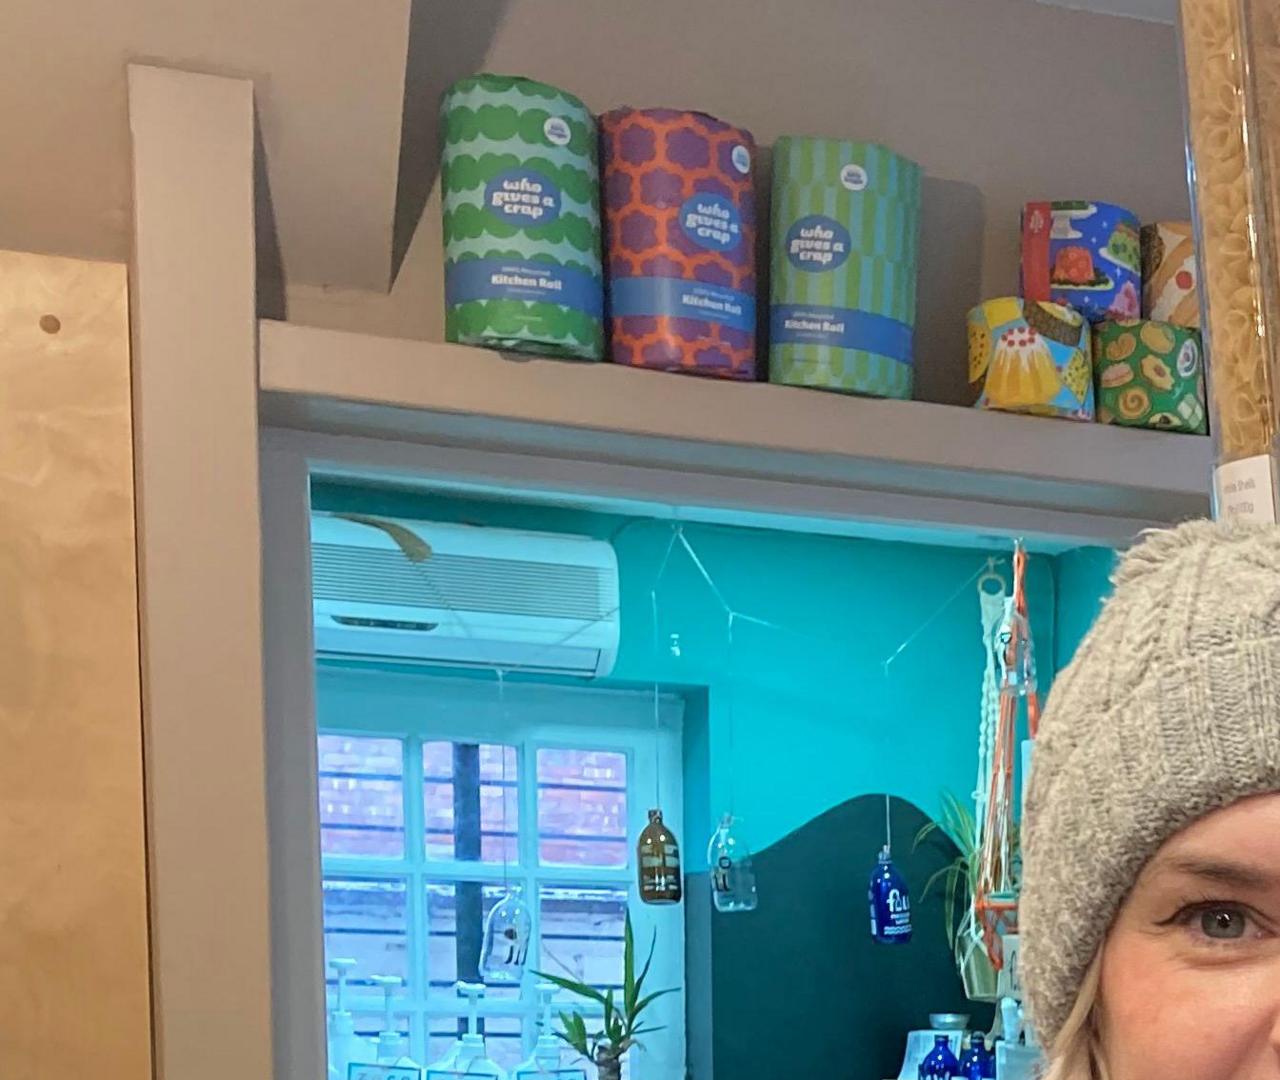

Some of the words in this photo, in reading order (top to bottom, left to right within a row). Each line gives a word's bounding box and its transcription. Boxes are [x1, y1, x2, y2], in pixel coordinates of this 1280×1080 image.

[502, 177, 542, 193] who
[503, 203, 544, 220] crap
[491, 274, 538, 288] Kitchen
[539, 278, 562, 291] Roll
